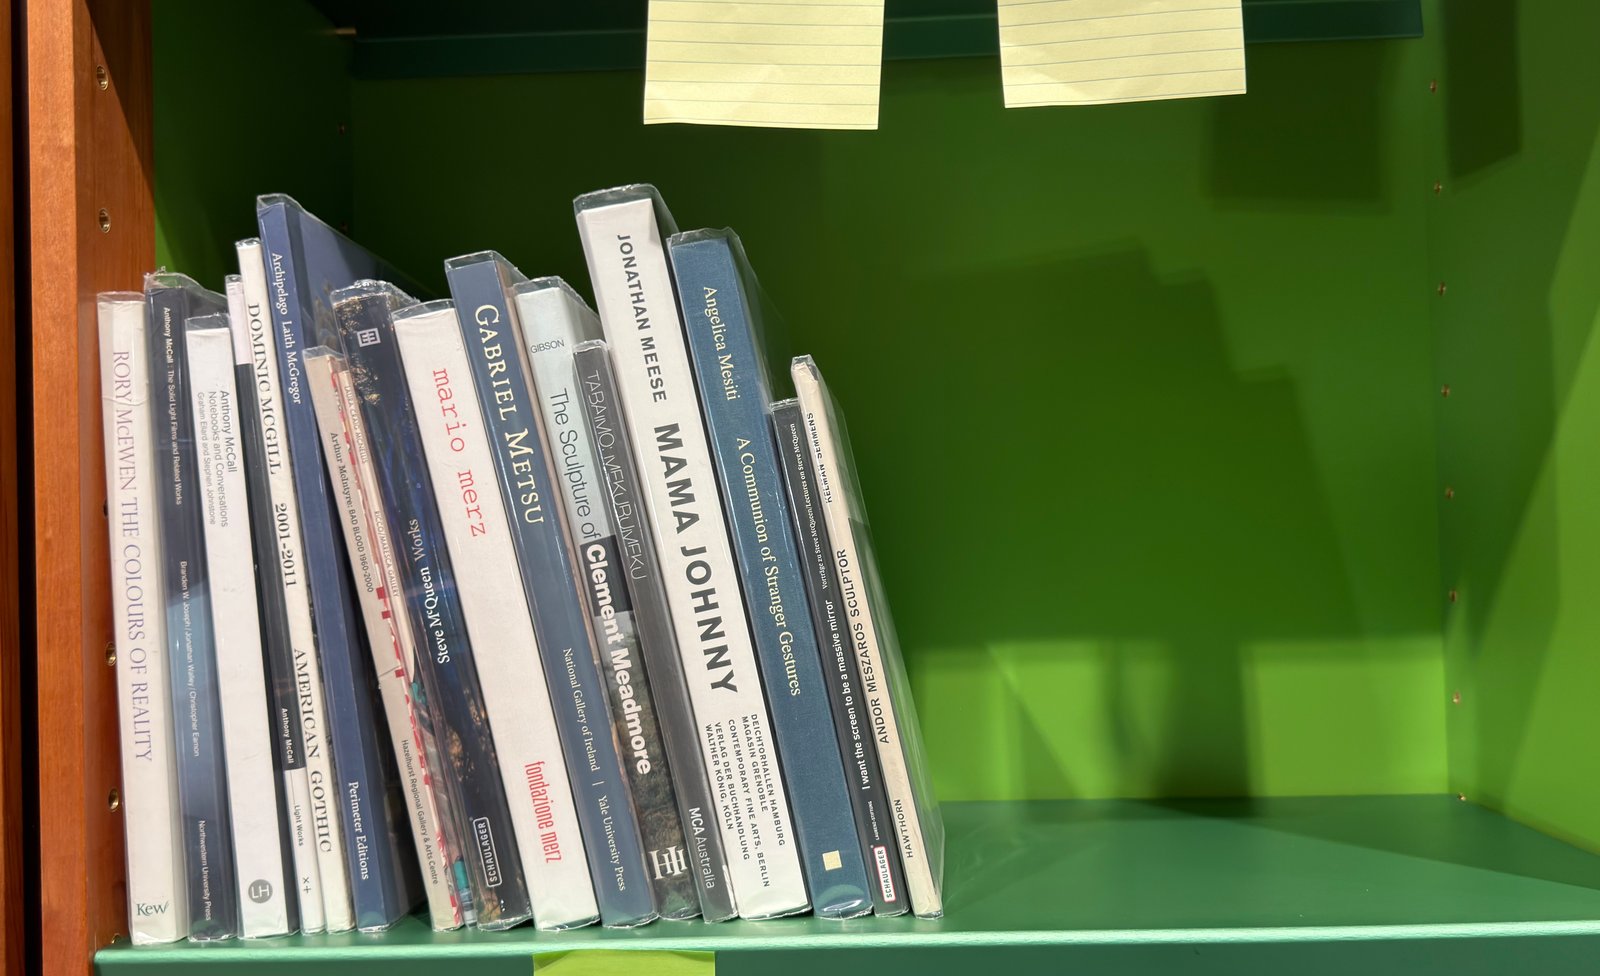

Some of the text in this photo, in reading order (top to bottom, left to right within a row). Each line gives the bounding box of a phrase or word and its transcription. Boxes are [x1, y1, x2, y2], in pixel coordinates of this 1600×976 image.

[269, 253, 301, 404] Archipelago Laith McGregor
[530, 340, 565, 353] GIBSON
[617, 234, 666, 402] JONATHAN MEESE
[702, 286, 740, 400] Angelica Mesiti
[248, 304, 280, 474] DOMINIC MCGILL
[474, 304, 545, 523] GABRIEL METSU
[197, 391, 217, 524] Graham Ellard and Stephen Johnstone
[208, 391, 228, 526] Notebooks and Conversations
[219, 390, 237, 472] Anthony McCall
[432, 368, 485, 536] mario merz
[330, 432, 373, 592] Arthur McIntyre: BAD BLOOD 1960-2000
[113, 351, 151, 760] RORY McEWEN THE COLOURS OF REALITY
[274, 503, 296, 586] 2001-2011
[654, 423, 737, 693] MAMA JOHNNY
[736, 437, 801, 695] A Communion of Stranger Gestures
[406, 518, 449, 663] Steve McQueen Works
[550, 388, 651, 774] The Sculpture of Clement Meadmore
[824, 599, 837, 630] mirror
[563, 647, 580, 688] National
[831, 633, 845, 671] massive
[835, 549, 888, 743] ANDOR MESZAROS SCULPTOR
[572, 689, 587, 723] Gallery
[841, 681, 850, 694] be
[844, 695, 852, 705] to
[281, 708, 294, 763] Anthony McCall
[293, 649, 330, 852] AMERICAN GOTHIC
[581, 725, 592, 735] of
[847, 707, 860, 740] screen
[854, 742, 863, 758] the
[401, 739, 415, 777] Hazelhurst
[584, 737, 600, 771] Ireland
[705, 724, 734, 829] WALTHER KÖNIG, KÖLN
[741, 716, 767, 811] MAGASIN GRENOBLE
[750, 714, 785, 845] DEICHTORHALLEN HAMBURG
[857, 759, 868, 784] want
[292, 805, 301, 823] Light
[410, 778, 422, 809] Regional
[525, 760, 561, 863] fondazione merz
[598, 795, 609, 814] Yale
[714, 722, 749, 859] VERLAG DER BUCHHANDLUNG
[728, 719, 769, 886] CONTEMPORARY FINE ARTS, BERLIN
[198, 820, 207, 865] Northwestern
[348, 781, 369, 879] Perimeter Editions
[416, 810, 427, 835] Gallery
[424, 844, 433, 859] Arts
[477, 821, 497, 881] SCHAULAGER
[602, 816, 620, 864] University
[893, 799, 912, 858] HAWTHORN
[201, 866, 210, 899] University
[428, 860, 438, 884] Centre
[614, 866, 626, 890] Press
[877, 849, 892, 898] SCHAULAGER
[136, 901, 169, 916] Kew
